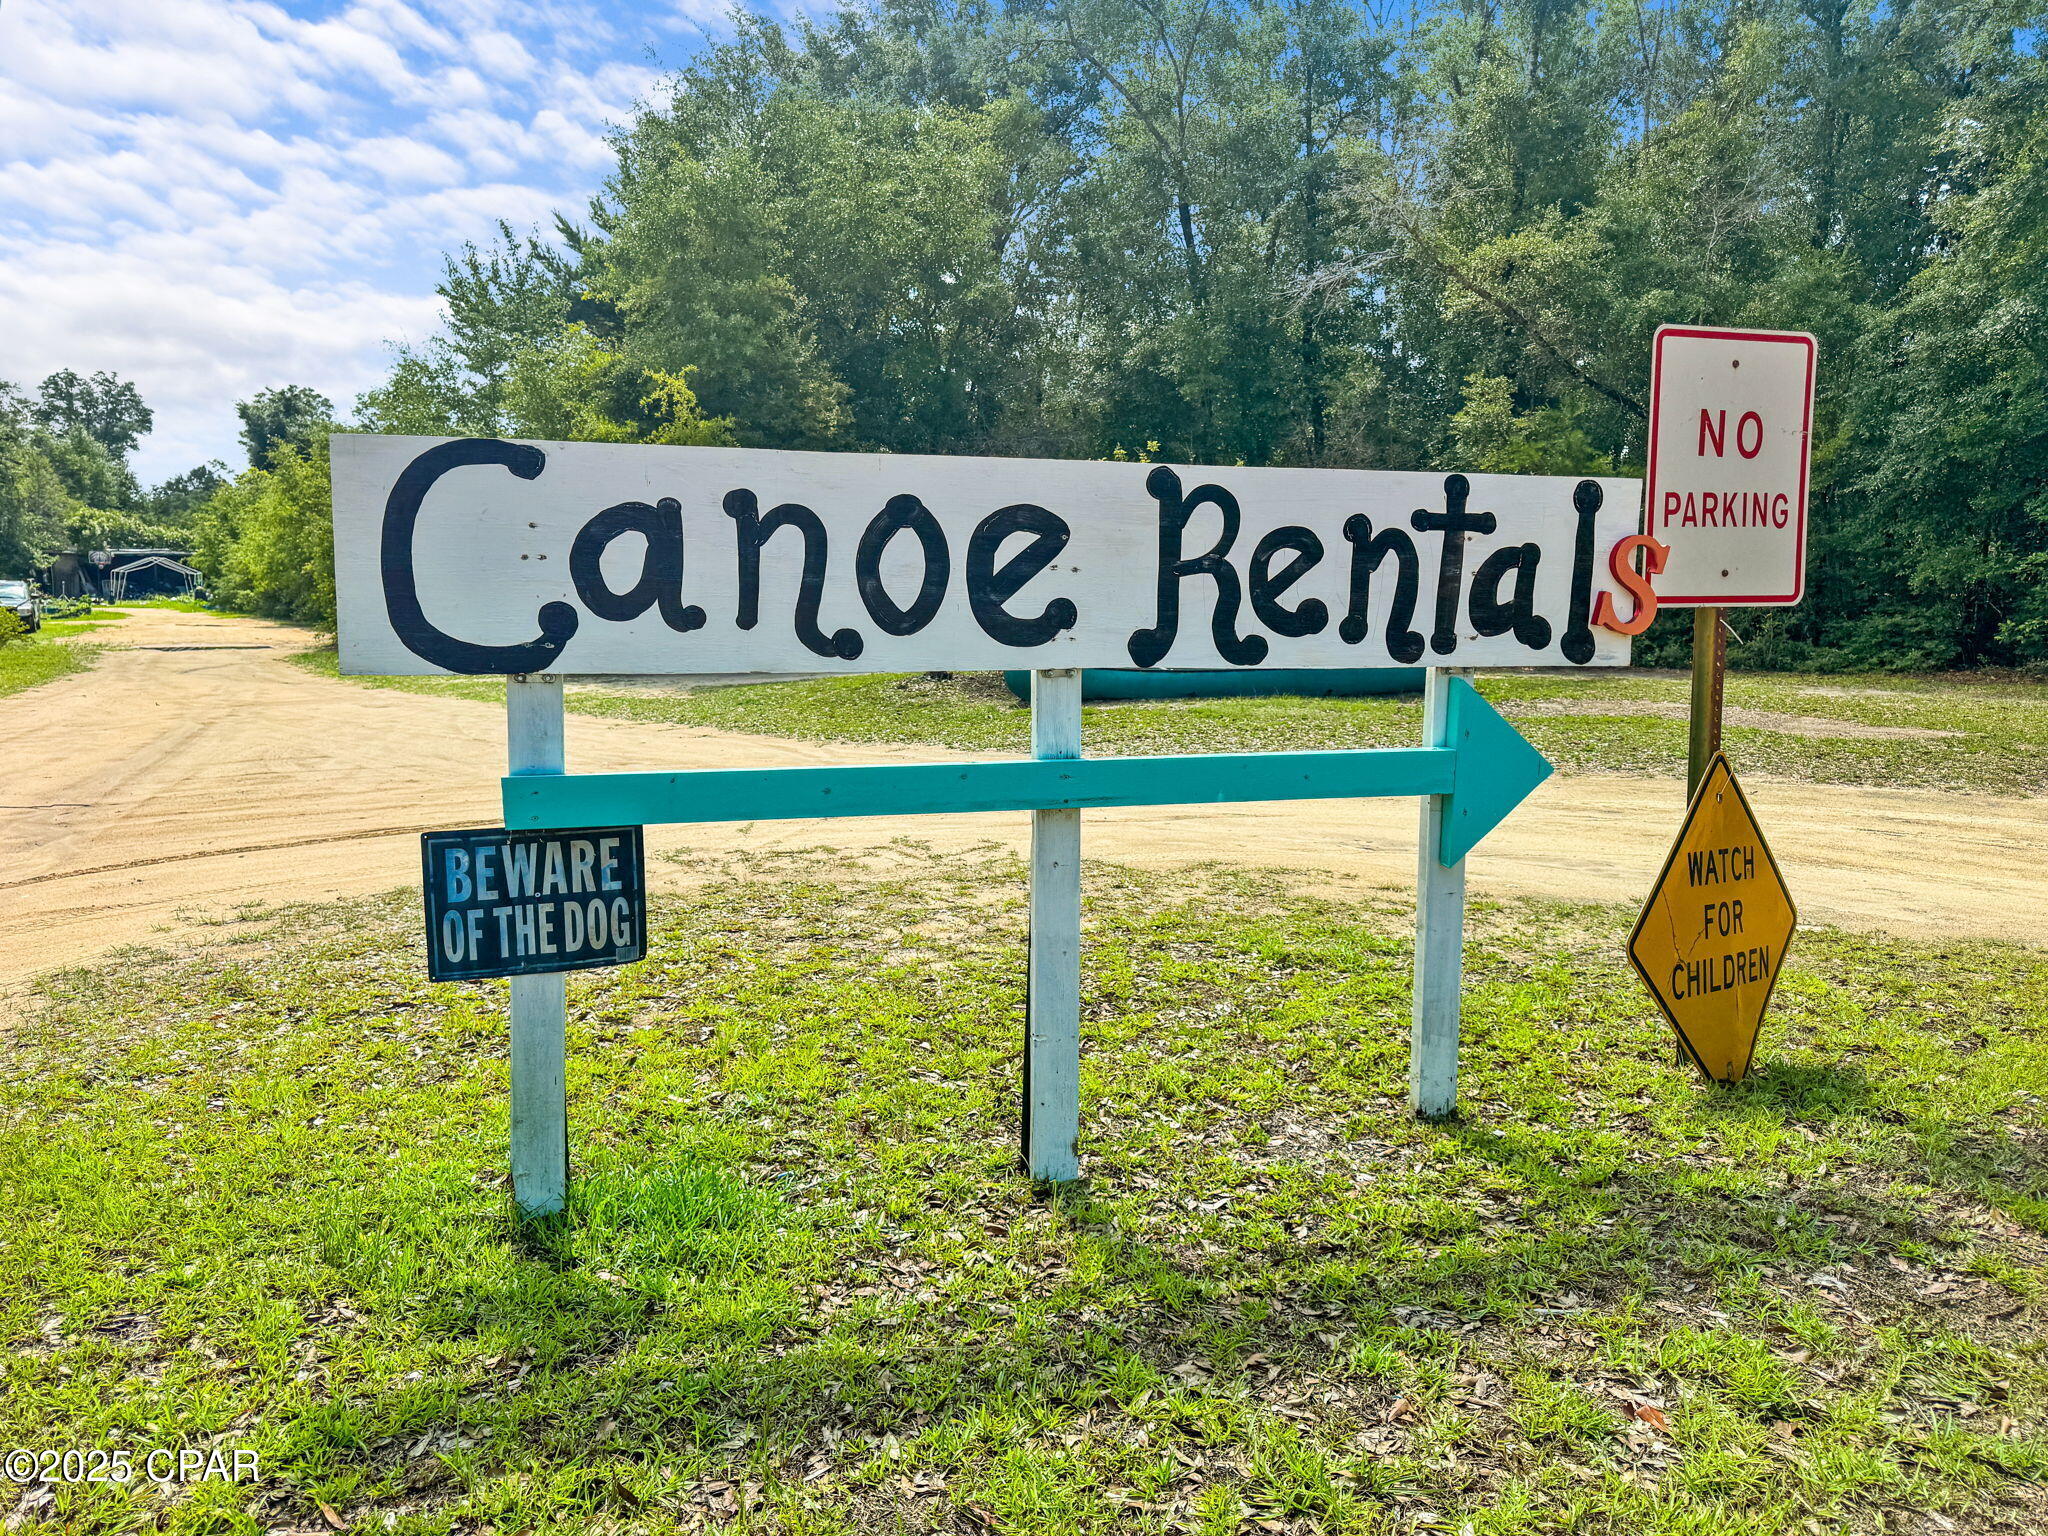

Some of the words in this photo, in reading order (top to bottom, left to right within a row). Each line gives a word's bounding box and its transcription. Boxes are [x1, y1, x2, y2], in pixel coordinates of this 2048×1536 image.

[1698, 408, 1763, 460] NO
[1663, 491, 1789, 530] PARKING
[381, 437, 1077, 675] Canoe
[1127, 465, 1671, 667] Rentals
[444, 837, 623, 904] BEWARE
[1687, 845, 1755, 888] WATCH
[443, 908, 484, 963] OF
[492, 902, 558, 958] THE
[563, 896, 631, 953] DOG
[1704, 899, 1744, 940] FOR
[1672, 945, 1770, 1000] CHILDREN
